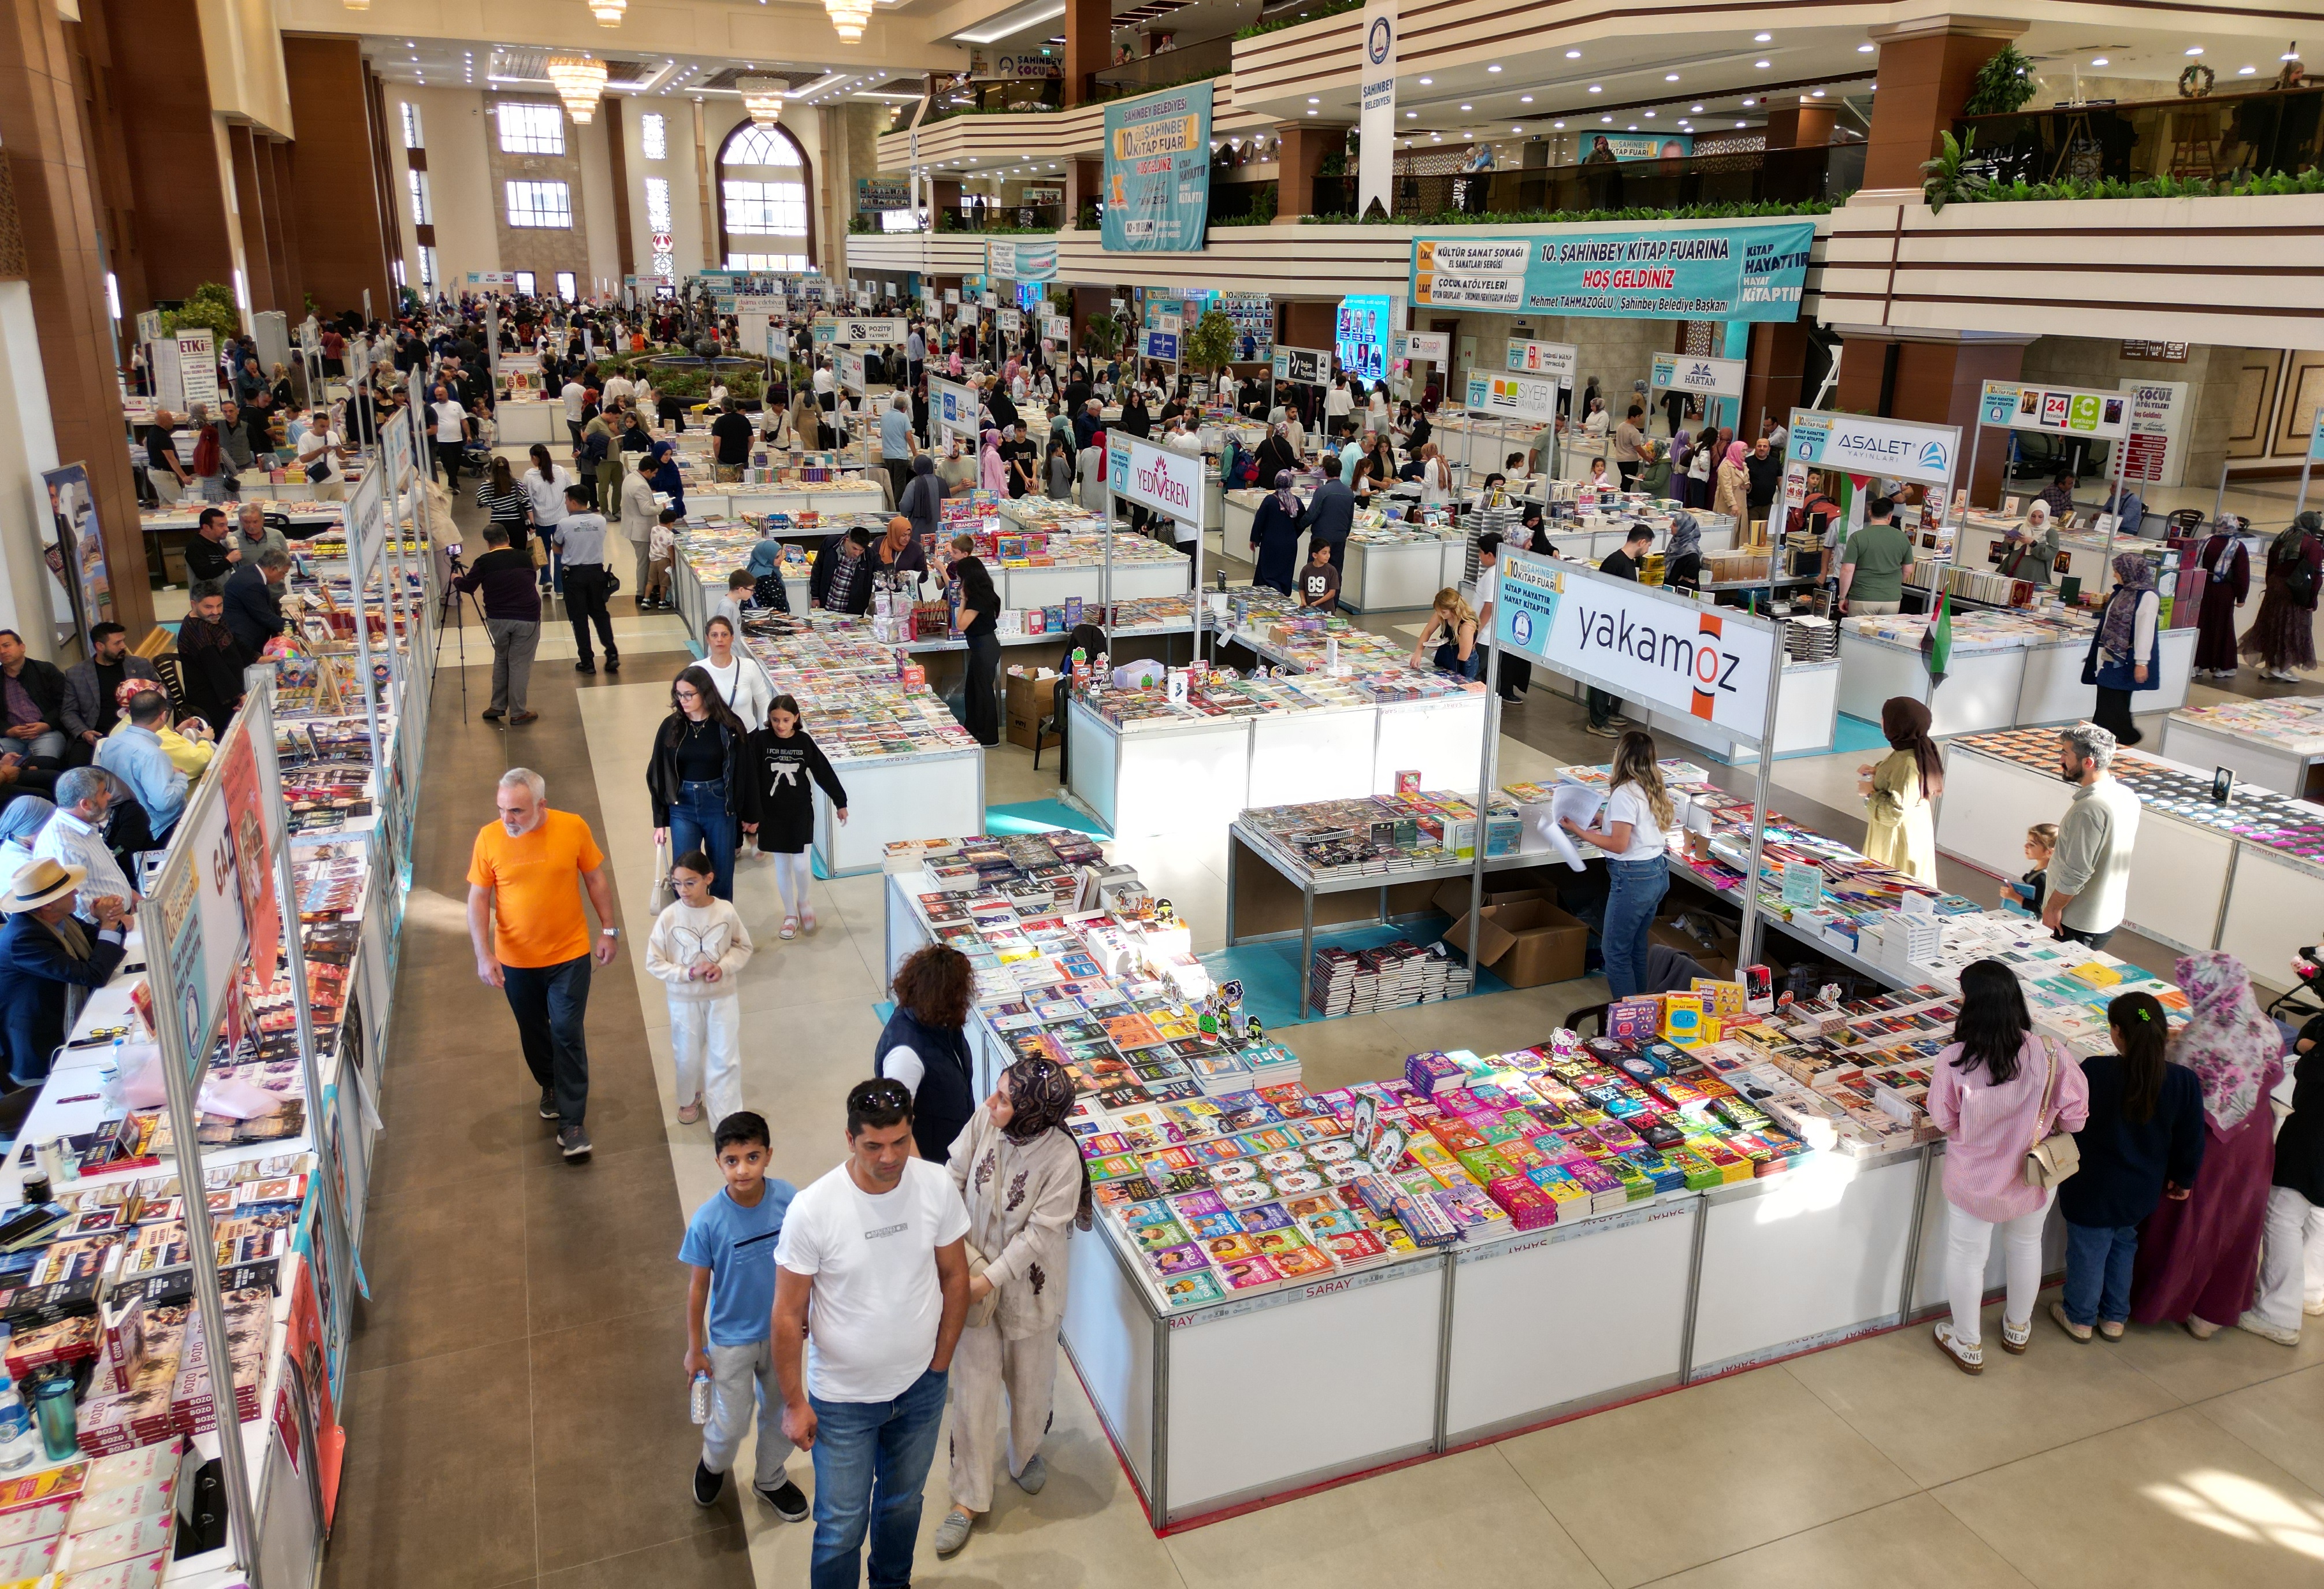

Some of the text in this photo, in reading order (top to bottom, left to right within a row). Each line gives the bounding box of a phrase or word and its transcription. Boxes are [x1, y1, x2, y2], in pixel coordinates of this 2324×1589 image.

[1018, 65, 1045, 76] ÇOCU
[1363, 78, 1394, 99] ŞAHİNBEY
[1124, 97, 1187, 123] ŞAHİNBEY BELEDİYESİ
[1365, 95, 1391, 110] BELEDİYESİ
[1145, 118, 1189, 141] ŞAHİNBEY
[1133, 135, 1186, 157] KİTAP FUARI
[1438, 247, 1524, 258] KÜLTÜR SANAT SOKAĞI
[1541, 237, 1729, 265] 10. ŞAHİNBEY KİTAP FUARINA
[1747, 244, 1774, 257] KİTAP
[1456, 260, 1482, 269] SANATLARI
[1483, 258, 1503, 269] SERGİSİ
[1744, 251, 1809, 274] HAYATTIR
[1438, 279, 1508, 289] ÇOCUK ATÖLYELERİ
[1581, 265, 1675, 291] HOŞ GELDİNİZ
[1743, 277, 1770, 285] HAYAT
[1529, 295, 1559, 307] Mehmet
[1560, 294, 1614, 309] TAHMAZOĞLU
[1620, 298, 1657, 312] Şahinbey
[1658, 298, 1694, 313] Belediye
[1695, 299, 1728, 314] Başkanı
[1684, 375, 1716, 386] HAKTAN
[1519, 383, 1547, 402] SİYER
[2139, 389, 2173, 402] ÇOCUK
[1519, 401, 1546, 411] YAYINLARI
[2047, 399, 2065, 413] 24
[1838, 434, 1912, 455] ASALET
[1848, 451, 1899, 463] YAYINLARI
[1308, 576, 1326, 593] 89
[1518, 571, 1556, 591] KİTAP FUARI
[1505, 582, 1550, 604] KİTAP HAYATTIR
[1504, 594, 1550, 615] HAYAT KİTAPTIR
[1578, 608, 1740, 692] yakamoz
[1774, 1096, 1798, 1104] NUTUK
[1306, 1278, 1352, 1297] SARAY
[191, 1341, 203, 1364] BOZO
[183, 1372, 196, 1394] BOZO
[190, 1395, 212, 1405] BOZO
[89, 1402, 105, 1426] BOZO
[190, 1406, 212, 1416] BOZO
[195, 1414, 216, 1424] BOZO
[96, 1426, 120, 1436] BOZO
[195, 1423, 217, 1433] BOZO
[101, 1434, 124, 1445] BOZO
[108, 1443, 131, 1454] BOZO
